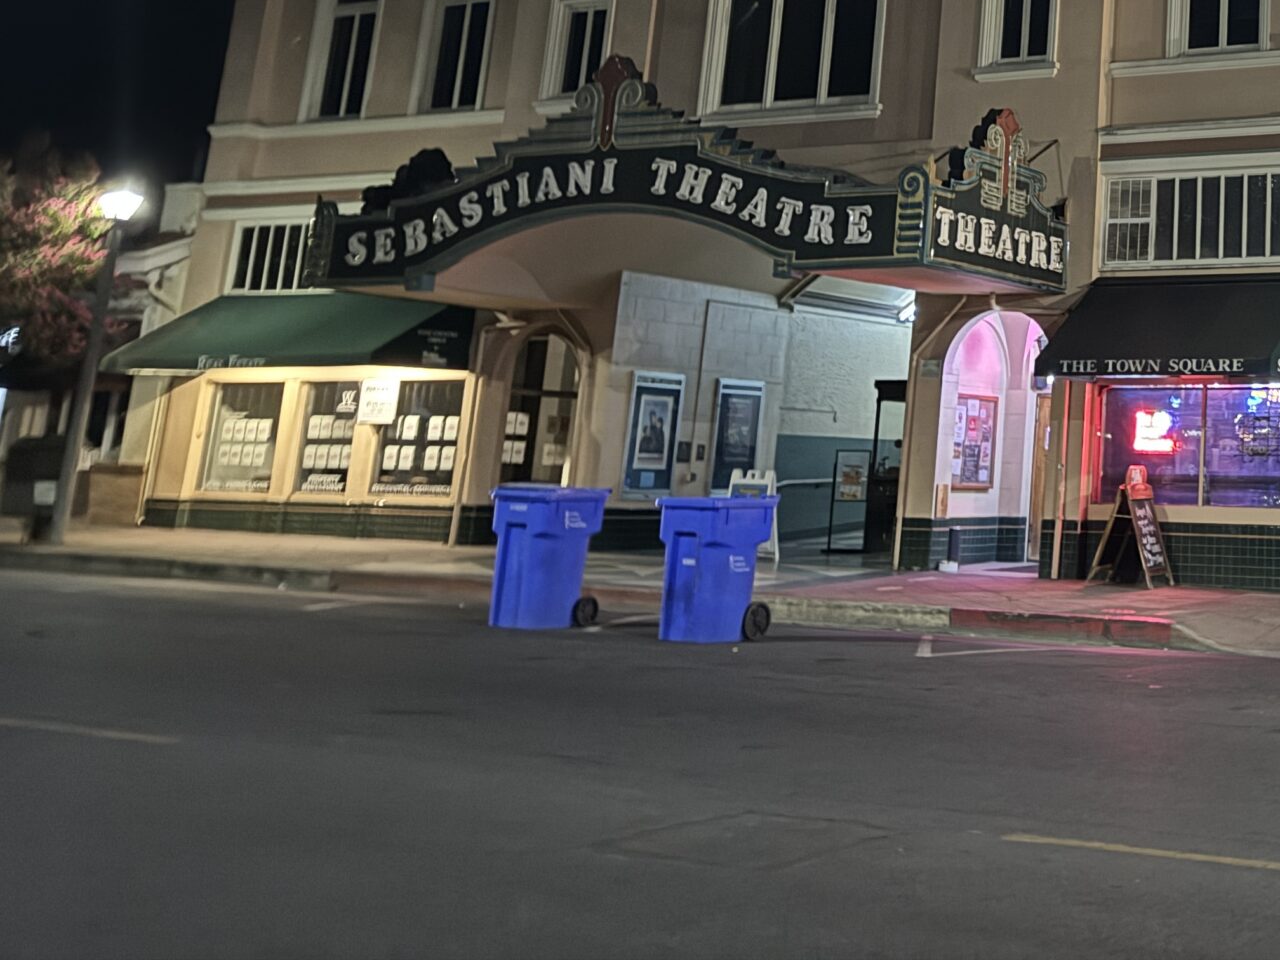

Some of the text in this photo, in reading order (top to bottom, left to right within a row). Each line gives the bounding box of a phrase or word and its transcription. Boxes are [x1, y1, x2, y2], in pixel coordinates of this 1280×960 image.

[344, 157, 874, 267] SEBASTIANI THEATRE
[935, 206, 1065, 275] THEATRE
[1060, 358, 1245, 373] THE TOWN SQUARE
